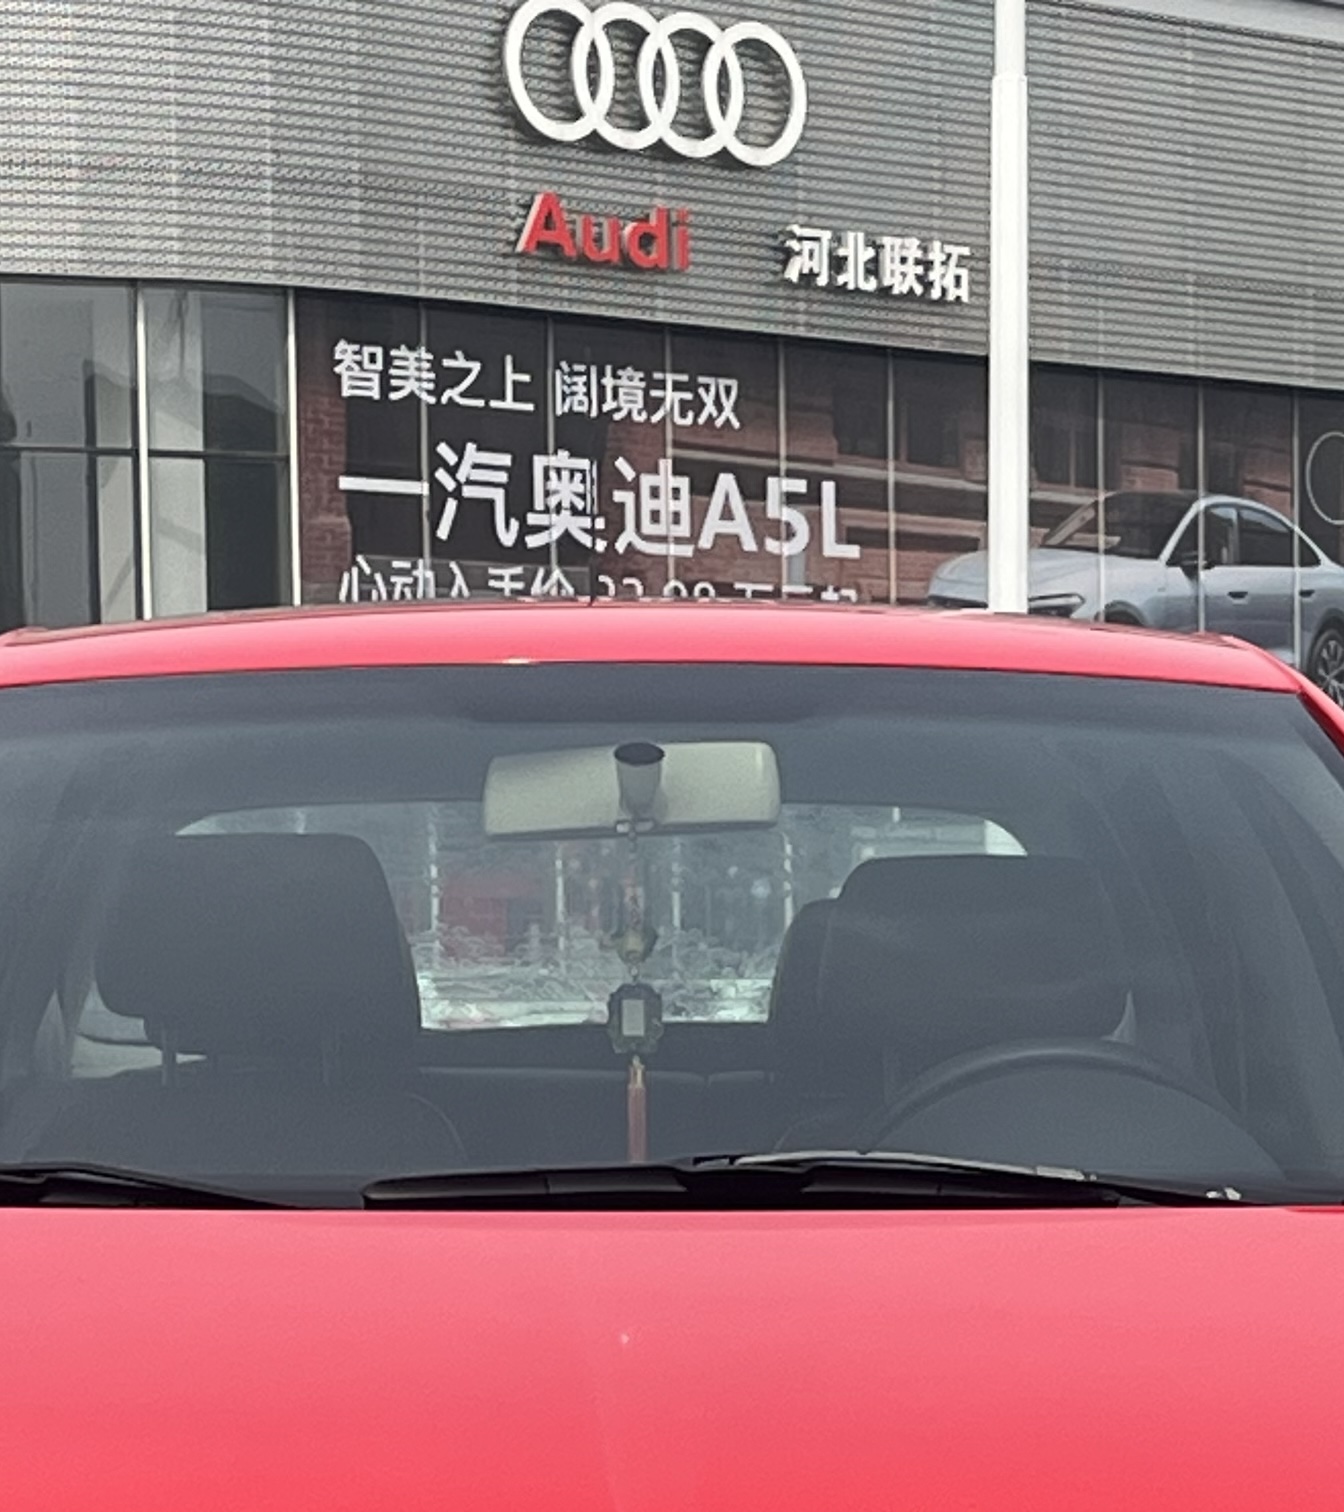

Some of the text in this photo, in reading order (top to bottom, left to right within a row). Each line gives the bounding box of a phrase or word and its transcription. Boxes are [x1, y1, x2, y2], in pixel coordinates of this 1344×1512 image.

[516, 191, 691, 271] Audi
[783, 224, 971, 302] 河北联拓
[332, 339, 742, 430] 智美之上 阔境无双
[338, 441, 862, 560] 一汽奥迪A5L
